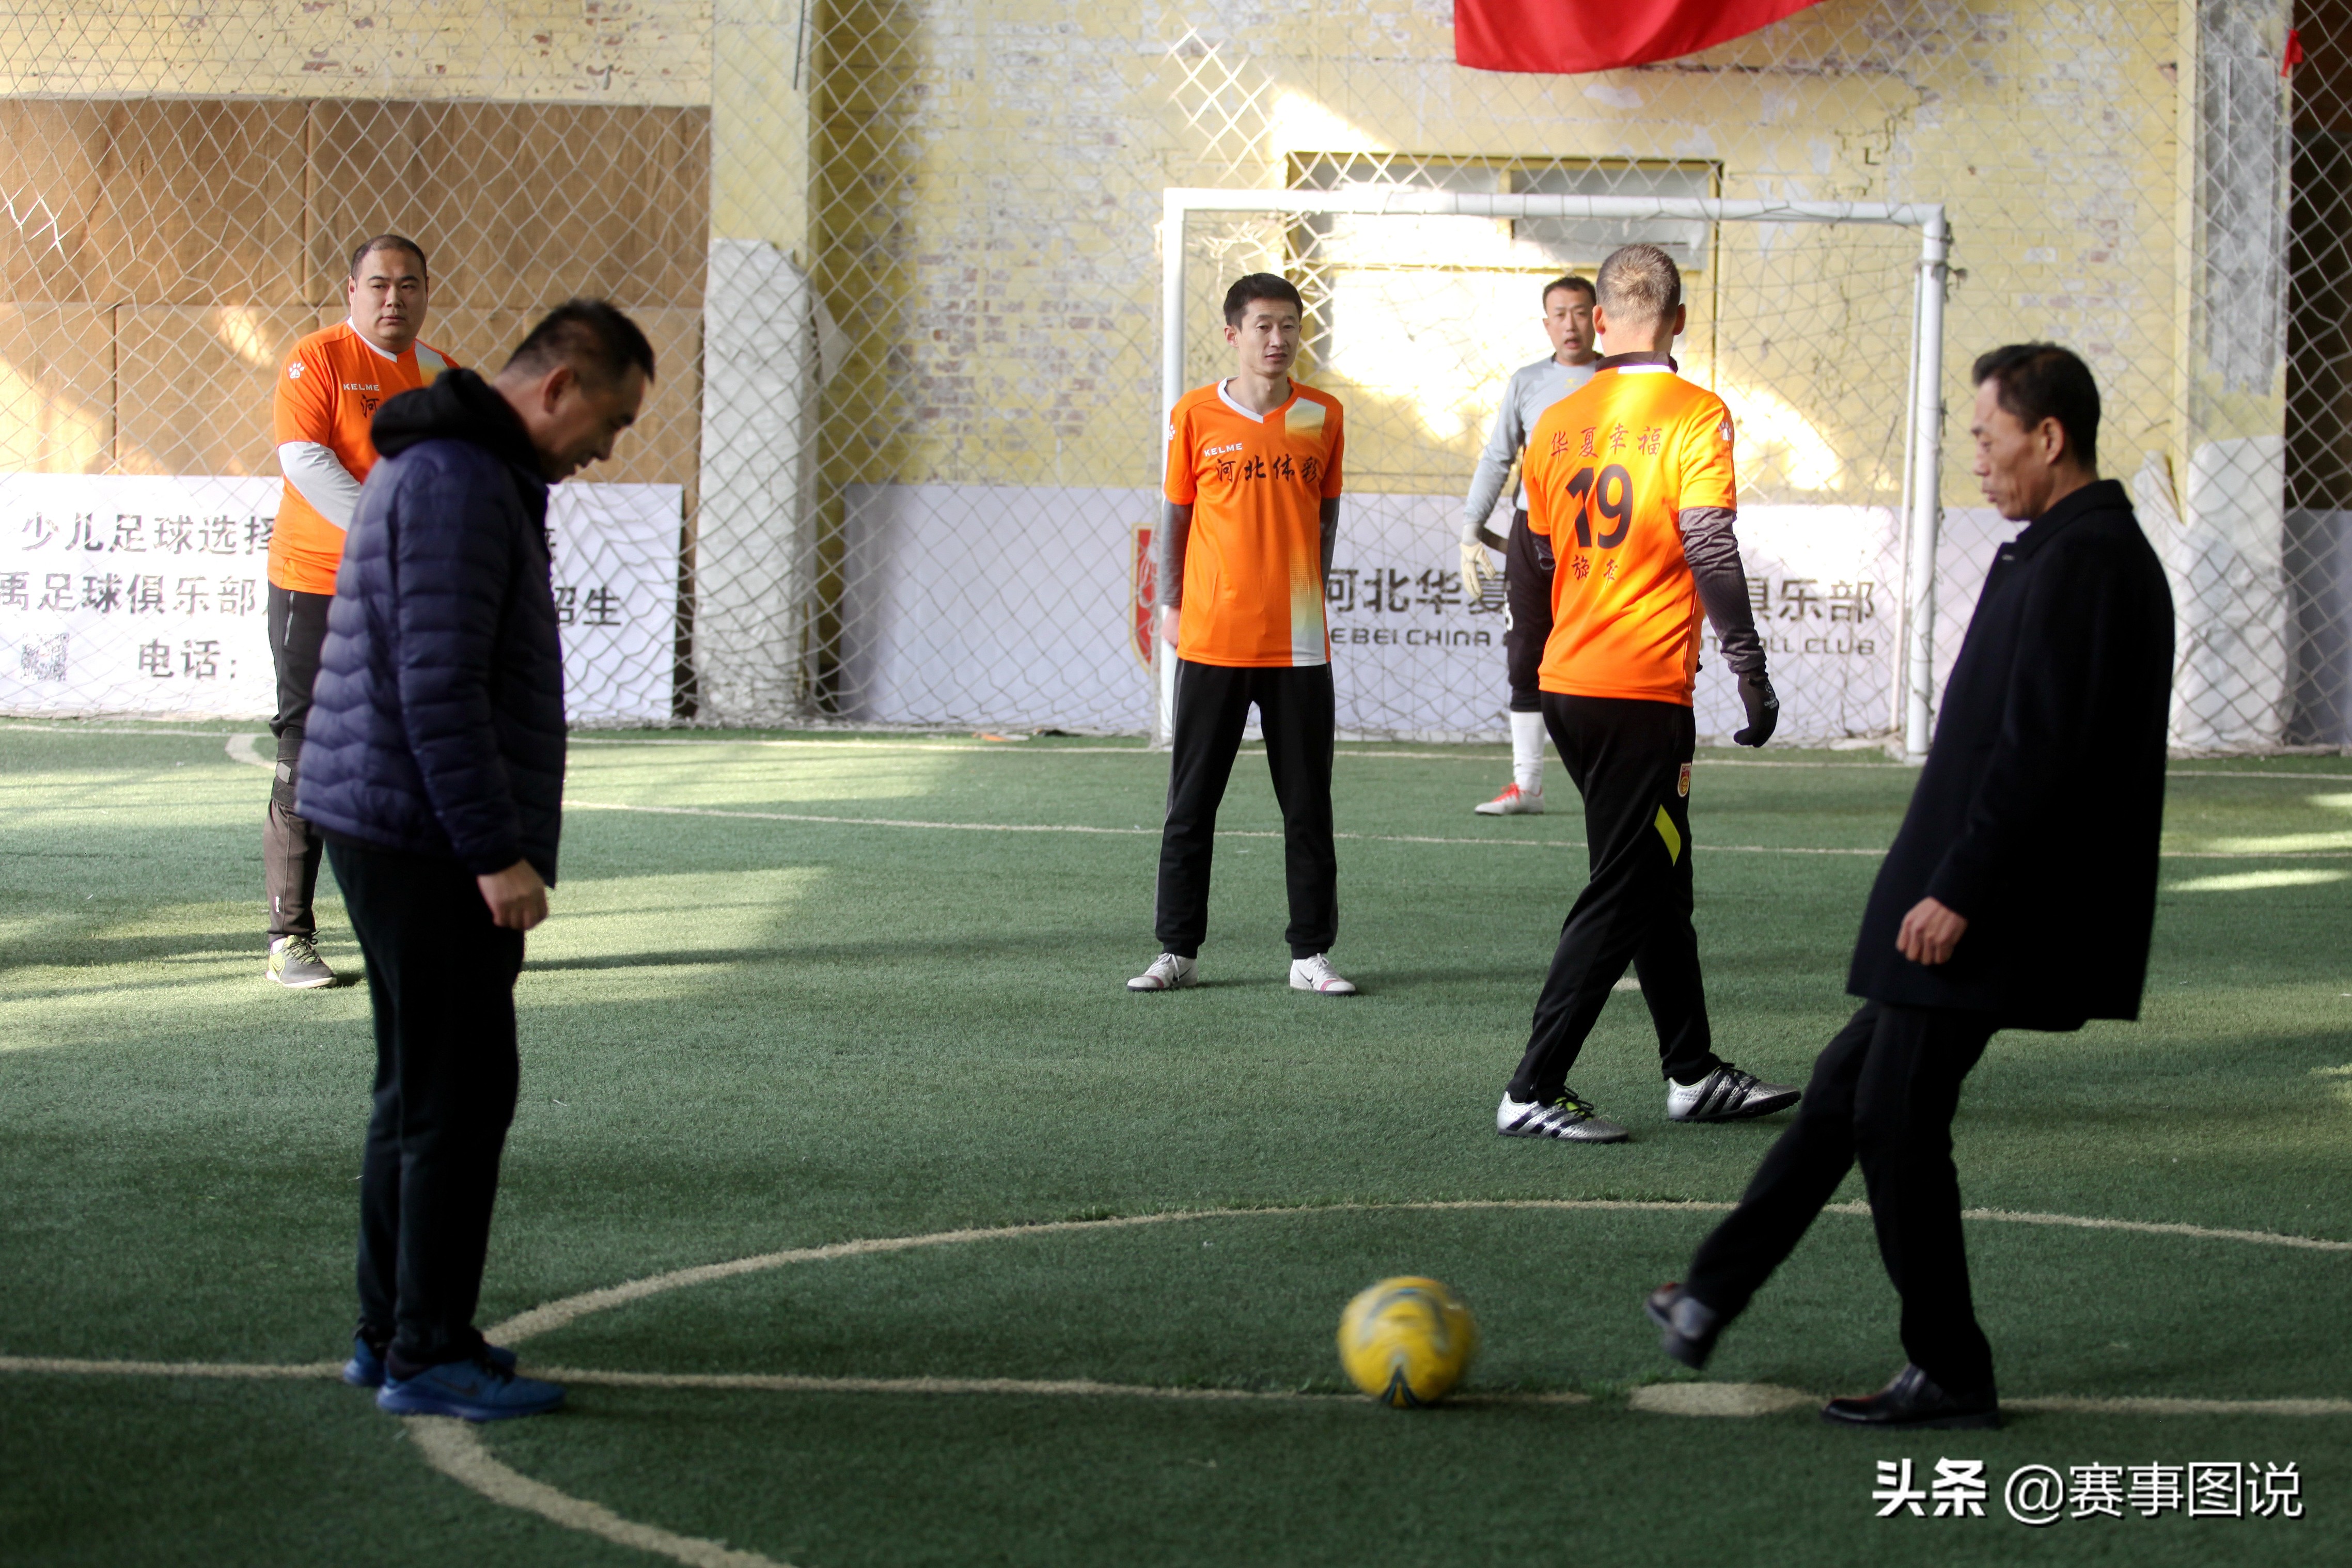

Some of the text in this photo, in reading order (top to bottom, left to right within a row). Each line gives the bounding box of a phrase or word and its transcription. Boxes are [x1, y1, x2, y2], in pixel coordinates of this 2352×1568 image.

[343, 383, 380, 391] KELME
[1203, 443, 1243, 458] KELME
[1550, 422, 1662, 463] 华夏幸福
[1215, 453, 1318, 484] 河北体彩
[1565, 464, 1633, 549] 19
[1330, 628, 1397, 645] EBEI
[1406, 630, 1491, 647] CHINA
[1806, 638, 1874, 655] CLUB
